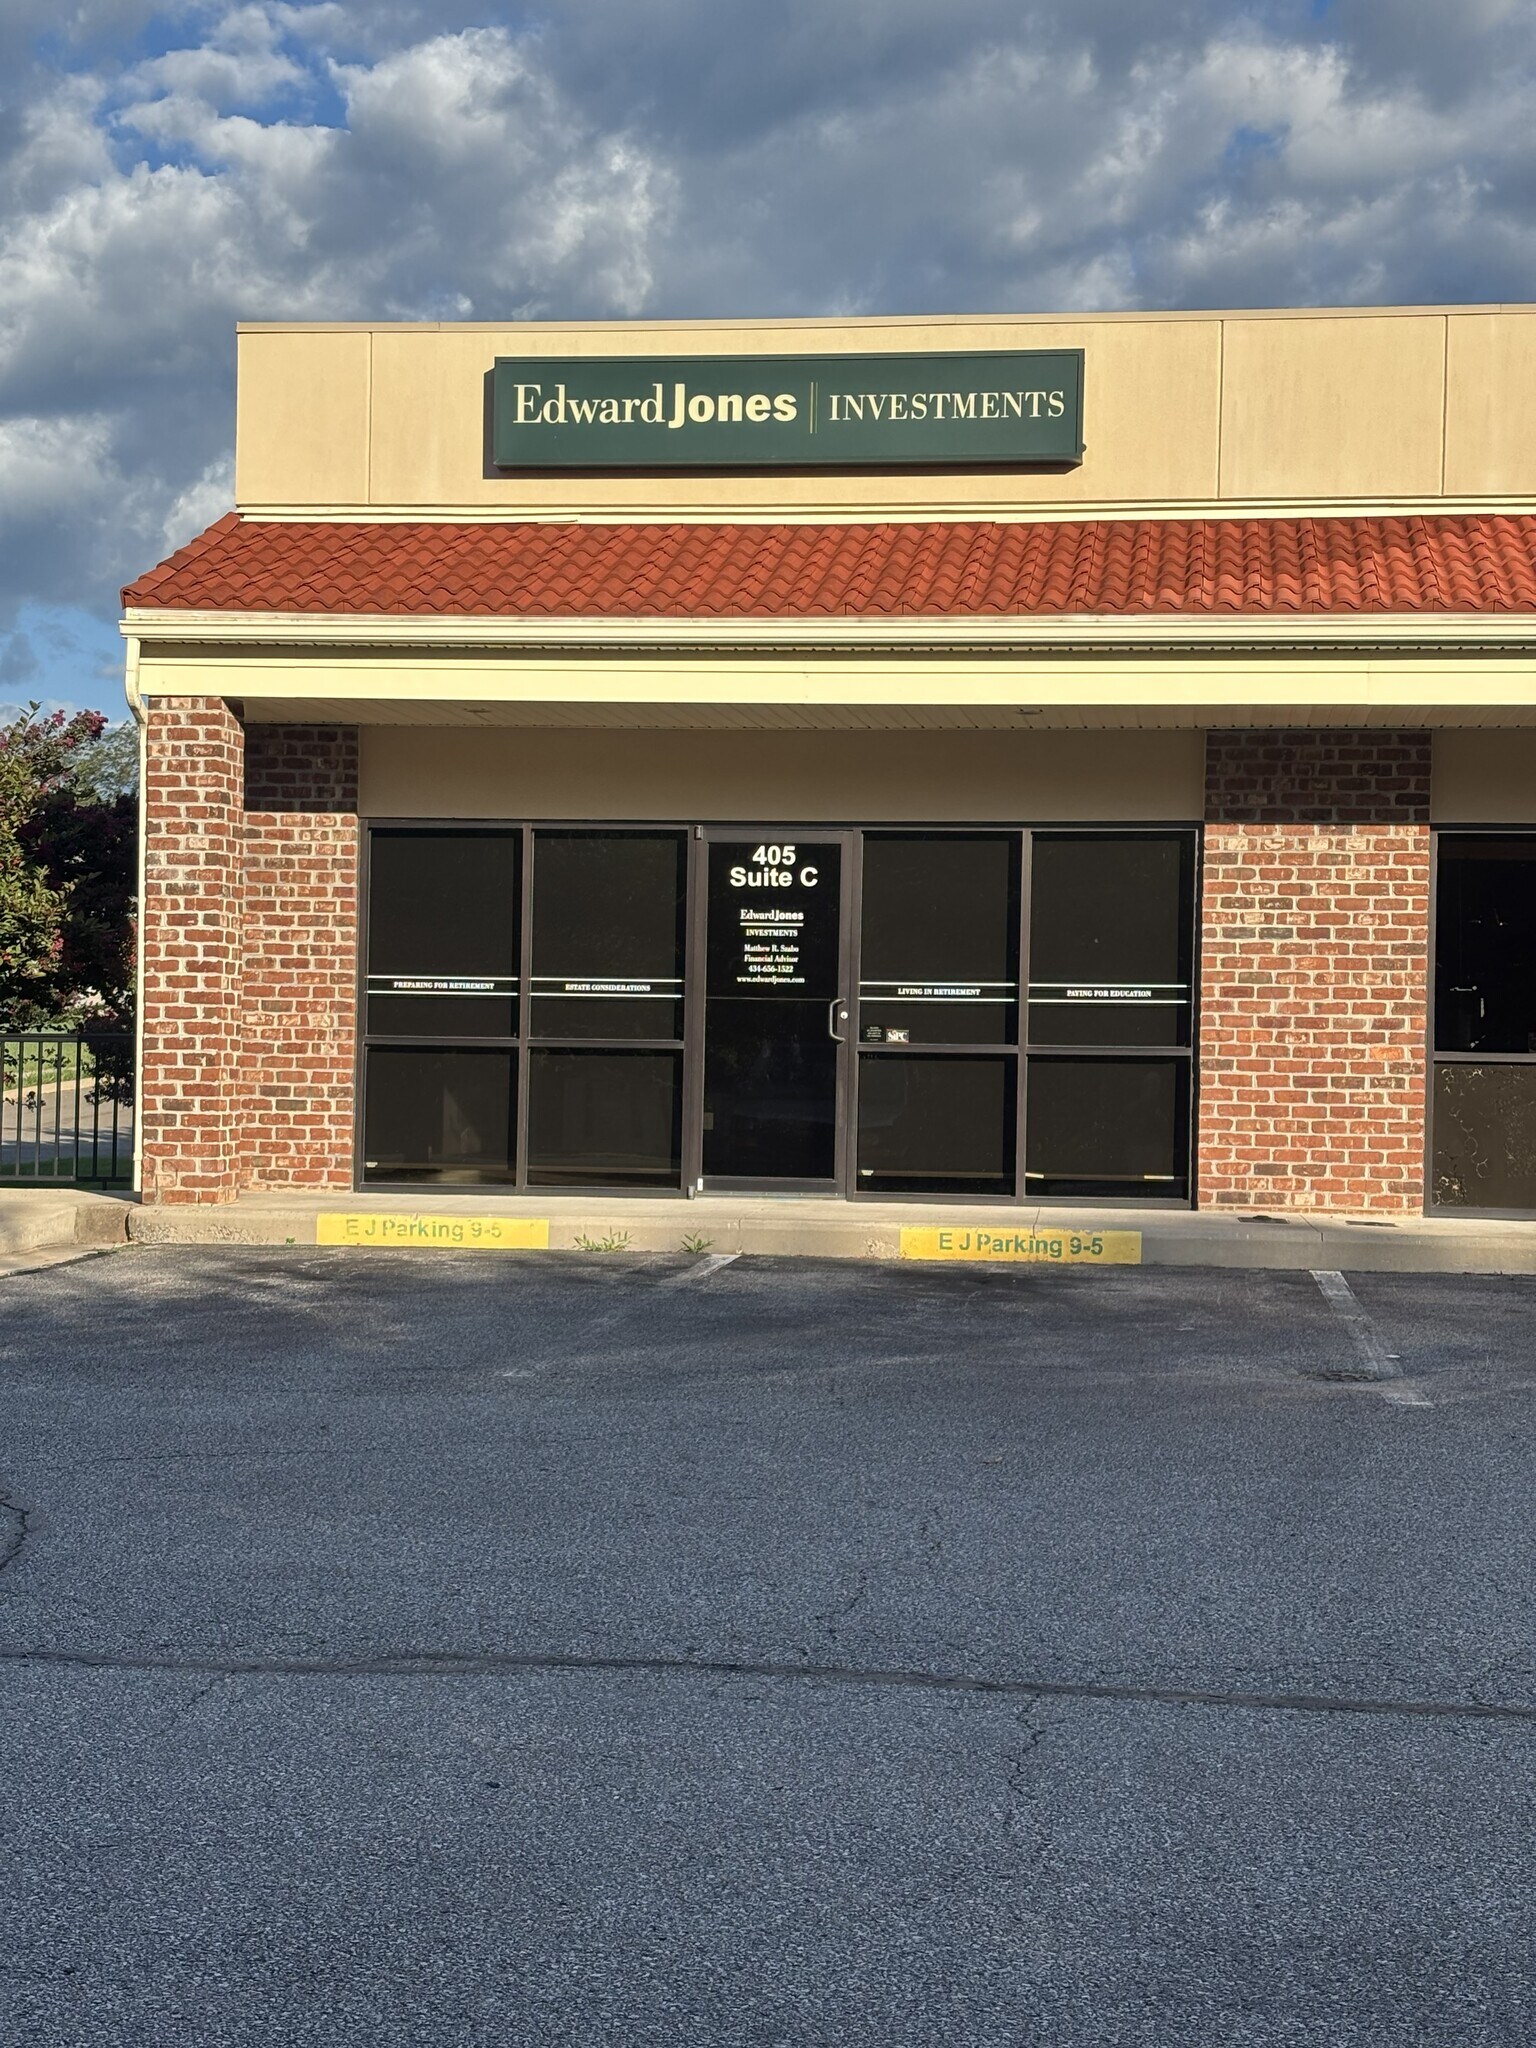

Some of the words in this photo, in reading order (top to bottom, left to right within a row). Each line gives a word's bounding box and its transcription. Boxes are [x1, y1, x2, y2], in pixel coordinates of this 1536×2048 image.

[829, 391, 1066, 422] INVESTMENTS
[752, 845, 796, 865] 405
[730, 867, 793, 887] Suite
[800, 867, 818, 887] C
[746, 929, 798, 937] INVESTMENTS
[744, 944, 770, 952] Matthew
[744, 954, 773, 962] Financial
[774, 955, 799, 963] Advisor
[737, 975, 805, 985] www.edwardjones.com
[393, 981, 433, 989] PREPARING
[449, 982, 495, 990] RETIREMENT
[565, 983, 591, 991] ESTATE
[591, 984, 651, 992] CONSIDERATIONS
[897, 987, 923, 995] LIVING
[933, 988, 981, 996] RETIREMENT
[1066, 989, 1093, 997] PAYING
[1110, 990, 1152, 998] EDUCATION
[346, 1219, 359, 1236] E
[365, 1219, 376, 1236] J
[382, 1219, 464, 1242] Parking
[471, 1221, 502, 1238] 9-5
[939, 1232, 953, 1250] E
[959, 1232, 970, 1250] J
[977, 1233, 1062, 1258] Parking
[1069, 1236, 1103, 1255] 9-5
